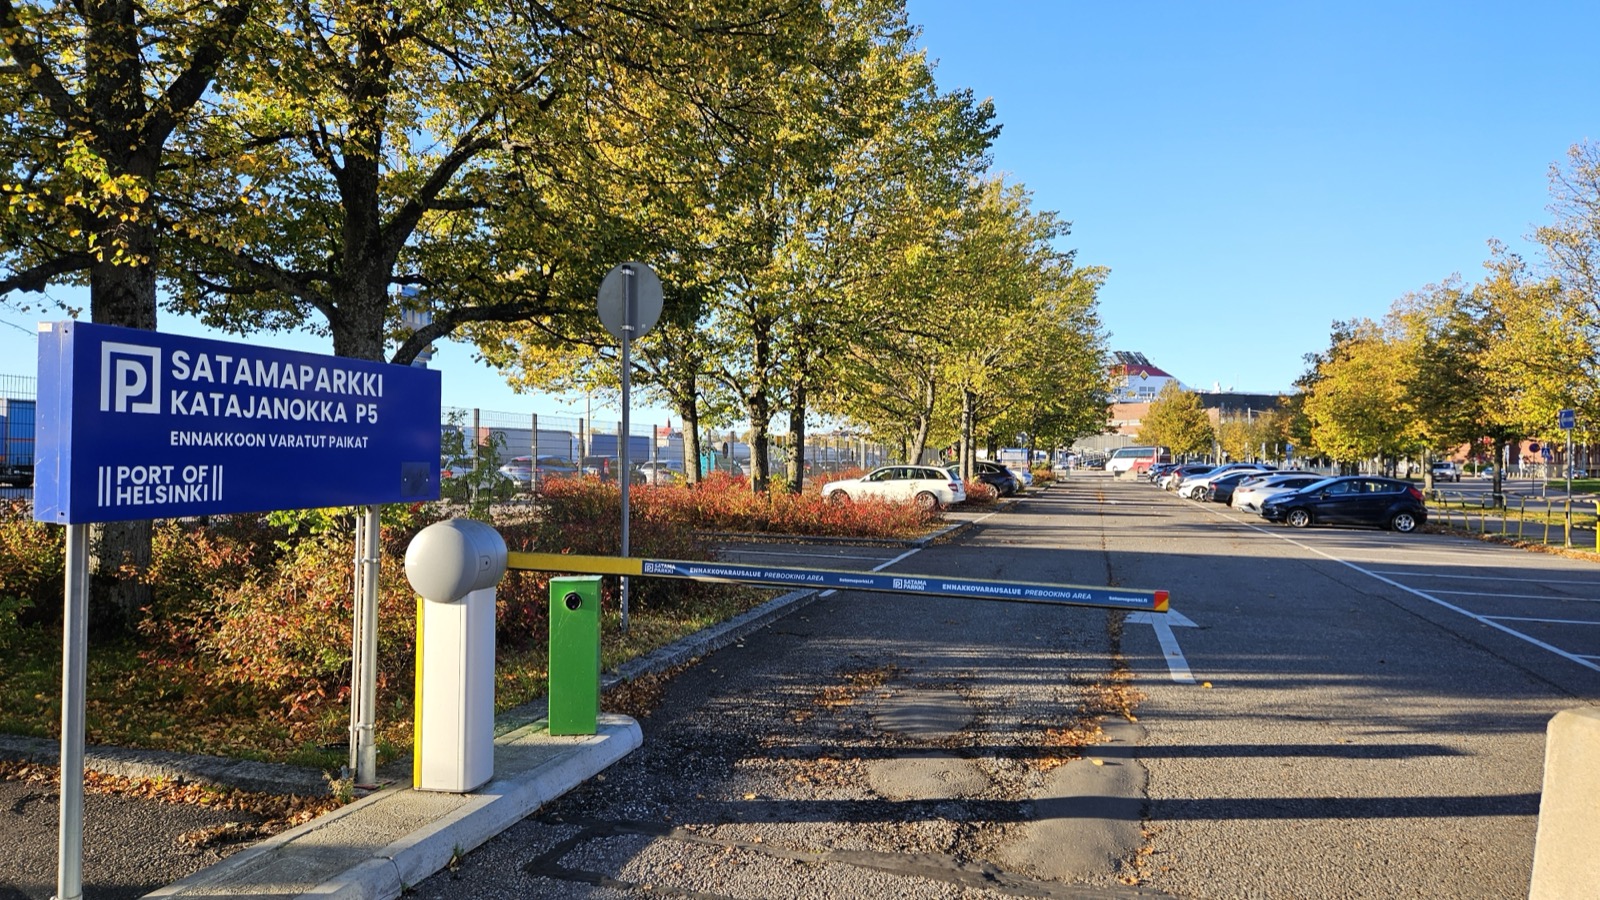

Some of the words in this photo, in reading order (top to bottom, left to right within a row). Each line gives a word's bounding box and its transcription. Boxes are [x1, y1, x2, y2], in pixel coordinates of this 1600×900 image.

[171, 350, 382, 397] SATAMAPARKKI
[170, 389, 348, 424] KATAJANOKKA
[355, 403, 378, 424] P5
[170, 430, 266, 448] ENNAKKOON
[269, 433, 327, 448] VARATUT
[328, 436, 369, 449] PAIKAT
[117, 465, 175, 486] PORT
[182, 464, 209, 484] OF
[116, 484, 208, 506] HELSINKI
[689, 567, 761, 577] ENNAKKOVARAUSALUE
[764, 572, 805, 581] PREBOOKING
[942, 583, 1021, 595] ENNAKKOVARAUSALUE
[1024, 589, 1071, 599] PREBOOKING
[1072, 592, 1092, 600] AREA
